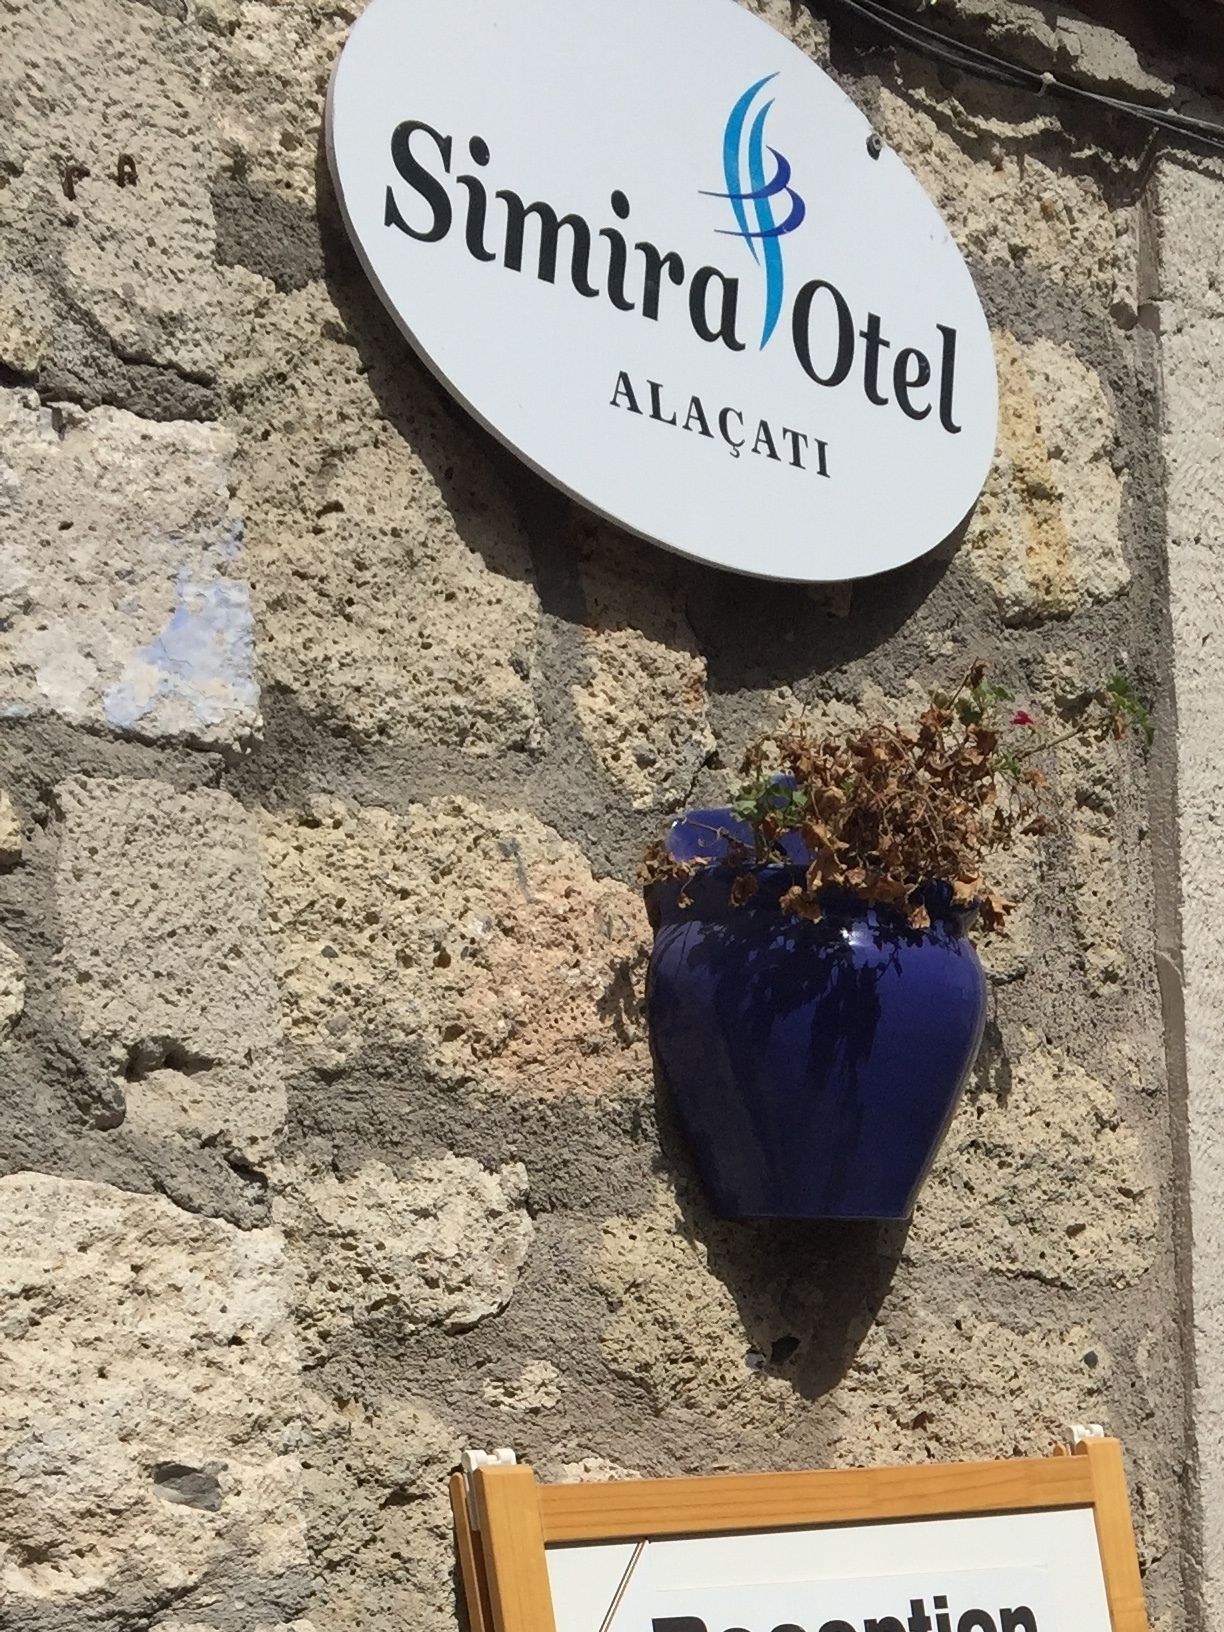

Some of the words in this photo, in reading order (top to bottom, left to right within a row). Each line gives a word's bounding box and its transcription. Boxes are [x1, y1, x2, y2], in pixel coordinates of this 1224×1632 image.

[385, 120, 746, 352] Simira
[791, 279, 962, 434] Otel
[609, 370, 831, 478] ALAÇATI
